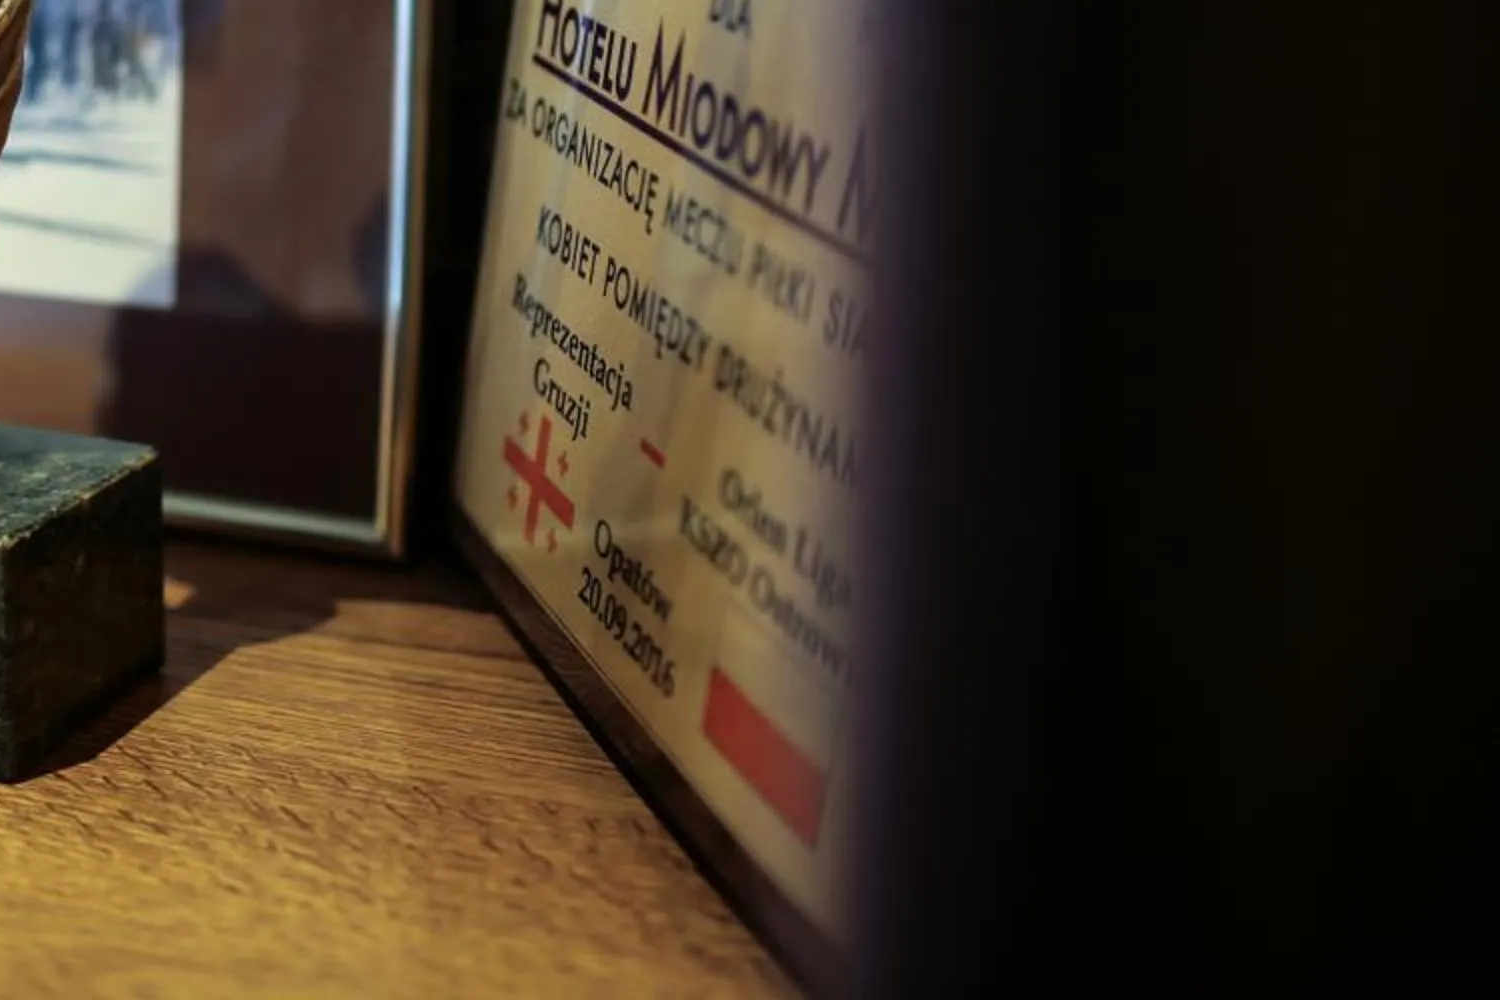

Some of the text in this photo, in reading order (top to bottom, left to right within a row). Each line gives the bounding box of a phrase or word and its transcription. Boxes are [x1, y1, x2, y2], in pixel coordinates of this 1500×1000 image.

[505, 79, 527, 127] ZA
[531, 98, 660, 235] ORGANIZACJĘ
[511, 273, 633, 411] Reprezentacja
[537, 204, 600, 285] KOBIET
[603, 254, 712, 371] POMIĘDZY
[533, 357, 591, 442] Gruzji
[578, 567, 677, 699] 20.09.2016
[594, 520, 673, 624] Opatów
